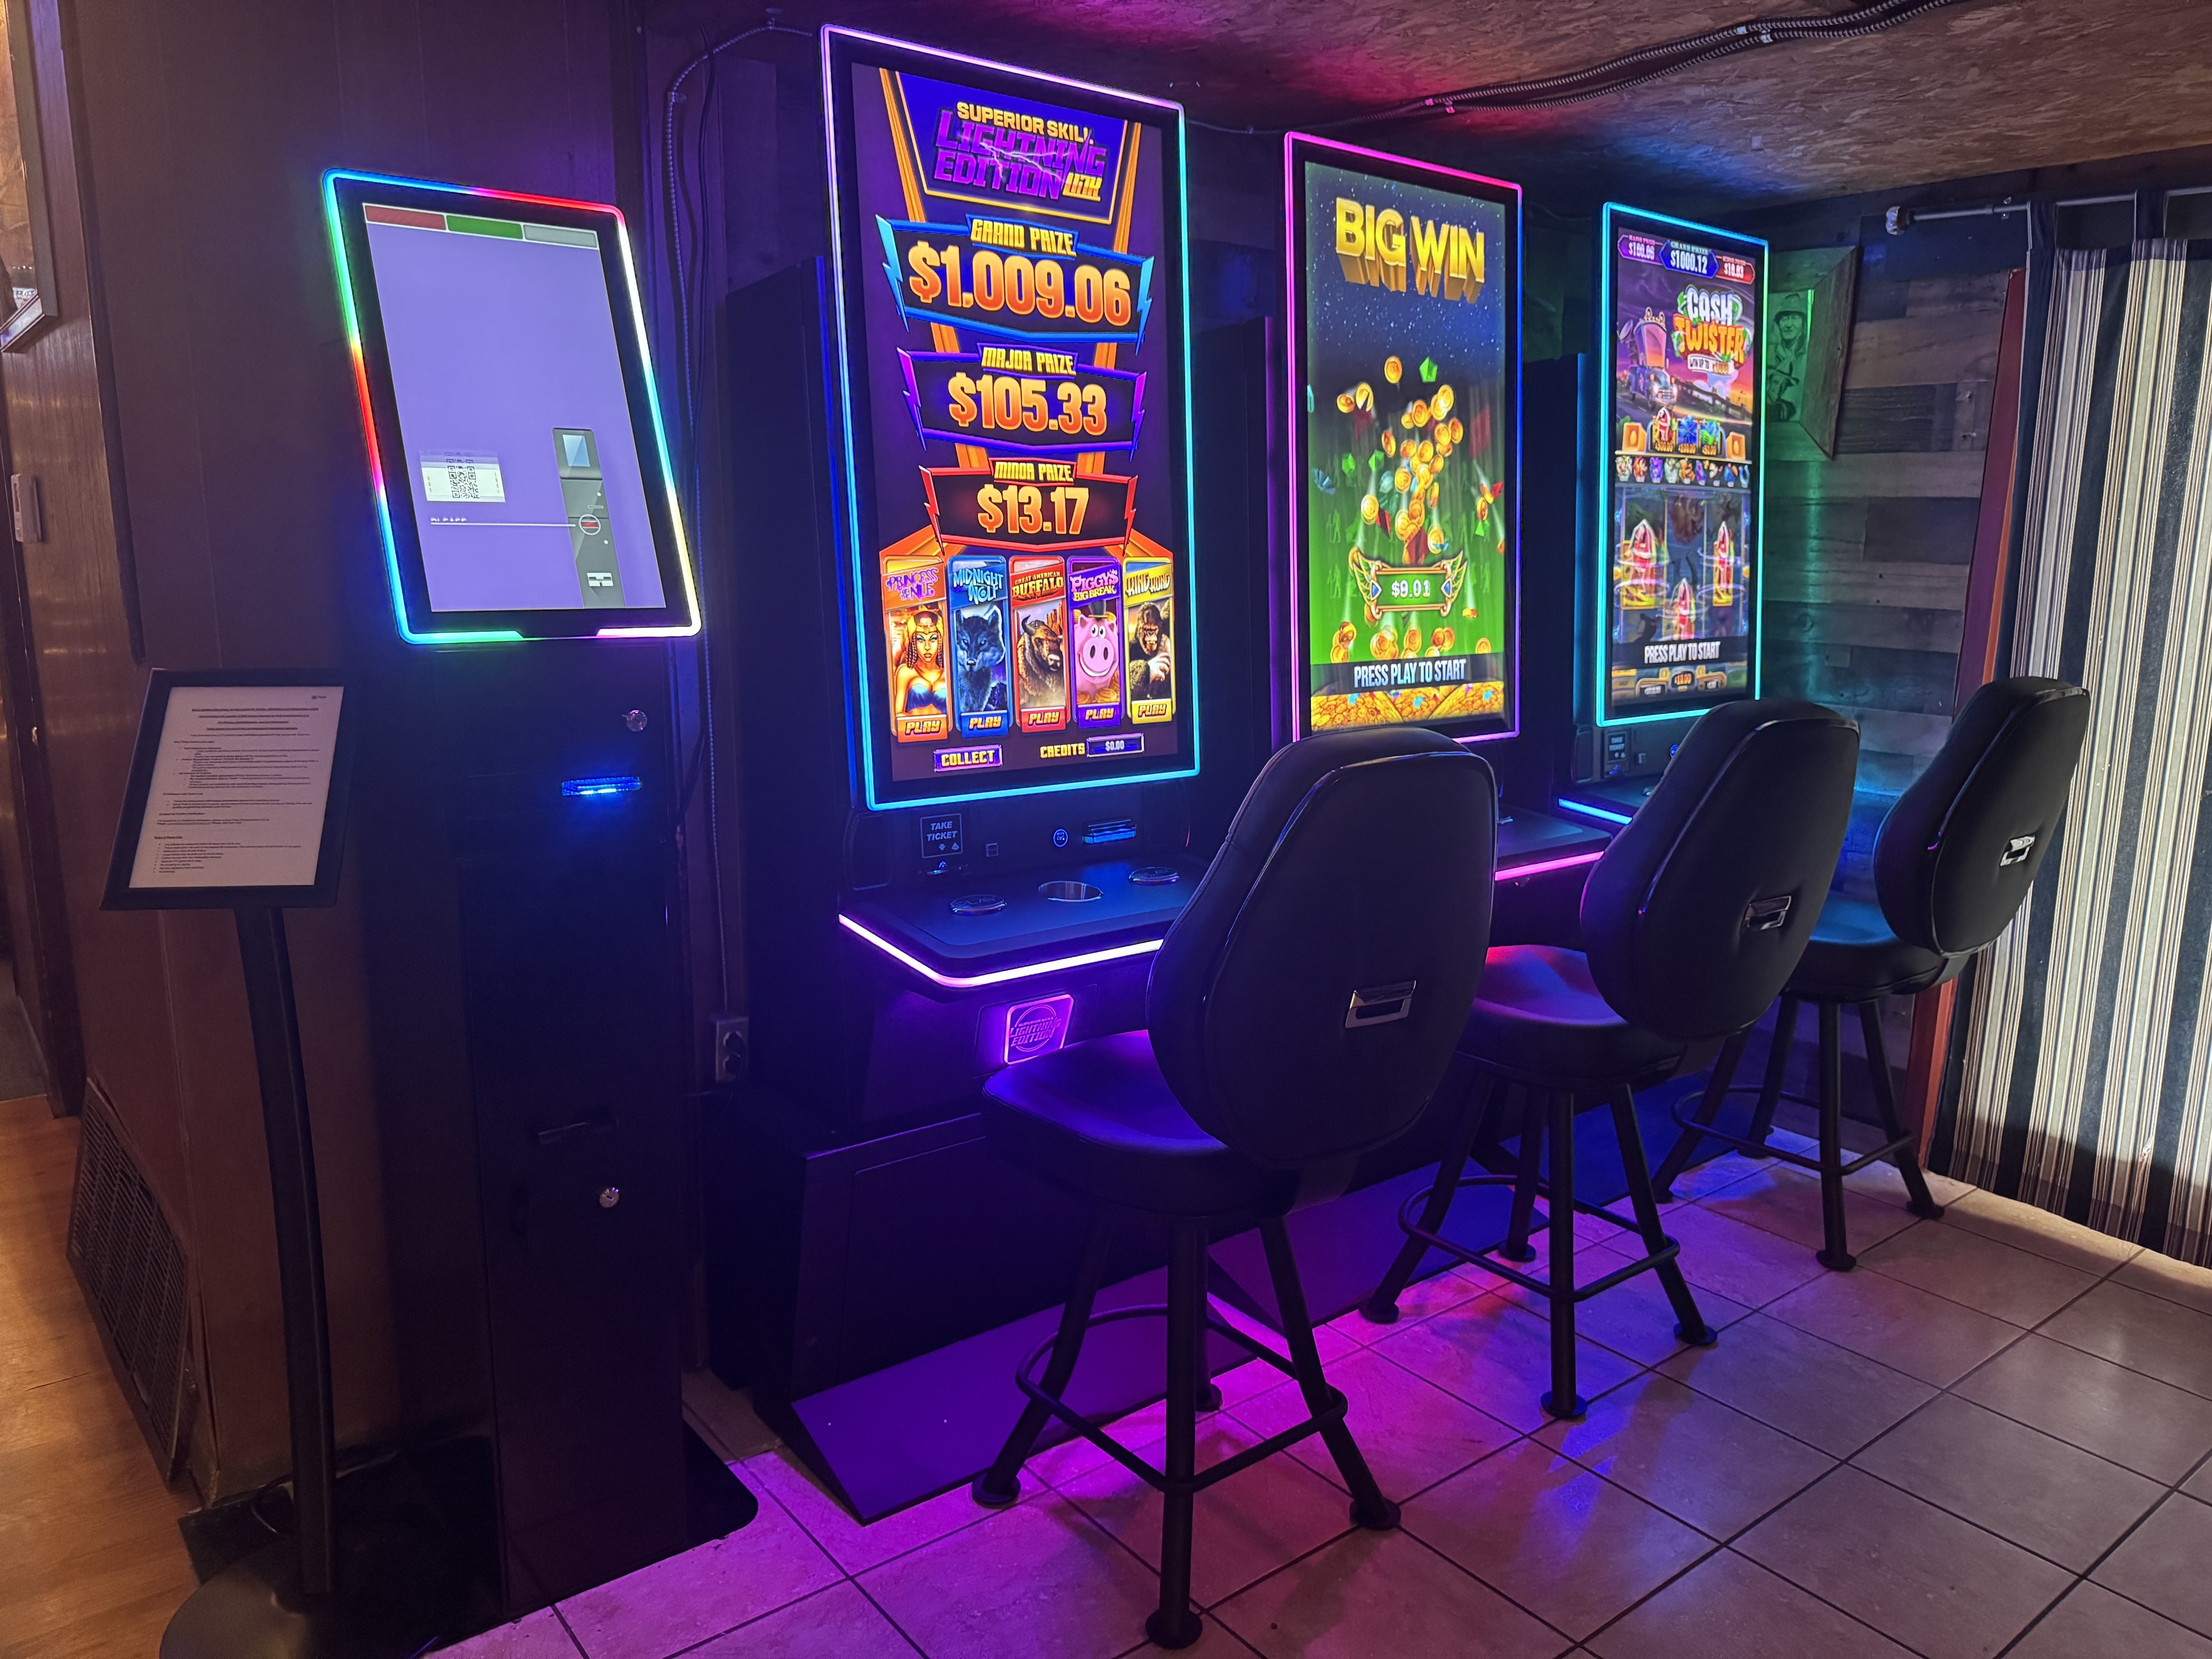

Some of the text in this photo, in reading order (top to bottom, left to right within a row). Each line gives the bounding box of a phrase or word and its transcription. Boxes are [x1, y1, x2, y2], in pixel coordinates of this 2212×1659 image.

[957, 101, 1094, 145] SUPERIOR SKILL
[936, 111, 1106, 177] LIGHTNING
[934, 149, 1063, 199] EDITION
[970, 218, 1077, 257] GRAND PRIZE
[1336, 197, 1485, 284] BIG WIN
[1670, 250, 1707, 274] $1000.12
[908, 240, 1131, 326] $1,009.06
[1686, 287, 1733, 326] CASH
[981, 347, 1077, 375] MAJOR PRIZE
[948, 371, 1107, 436] $105.33
[994, 461, 1074, 483] MINOR PRIZE
[977, 483, 1089, 535] $13.17
[886, 567, 939, 591] PRINCESS
[953, 568, 1004, 590] MIDNIGHT
[1012, 576, 1064, 598] BUFFALO
[1015, 571, 1061, 586] GREAT AMERICAN
[1126, 573, 1171, 597] KING KONG
[1391, 579, 1431, 598] $9.01
[968, 582, 999, 605] WOLF
[1073, 585, 1117, 602] BIG BREAK
[1644, 641, 1721, 664] PRESS PLAY TO START
[1354, 659, 1467, 689] PRESS PLAY TO START
[1028, 711, 1060, 726] PLAY
[1085, 708, 1115, 721] PLAY
[1139, 704, 1167, 716] PLAY
[905, 720, 941, 735] PLAY
[969, 716, 1002, 730] PLAY
[1040, 742, 1085, 759] CREDITS
[1105, 740, 1125, 752] $0.00
[941, 750, 995, 767] COLLECT
[926, 831, 958, 842] TICKET
[931, 821, 953, 831] TAKE
[1009, 1017, 1062, 1038] LIGHTNING
[1011, 1029, 1054, 1047] EDITION
